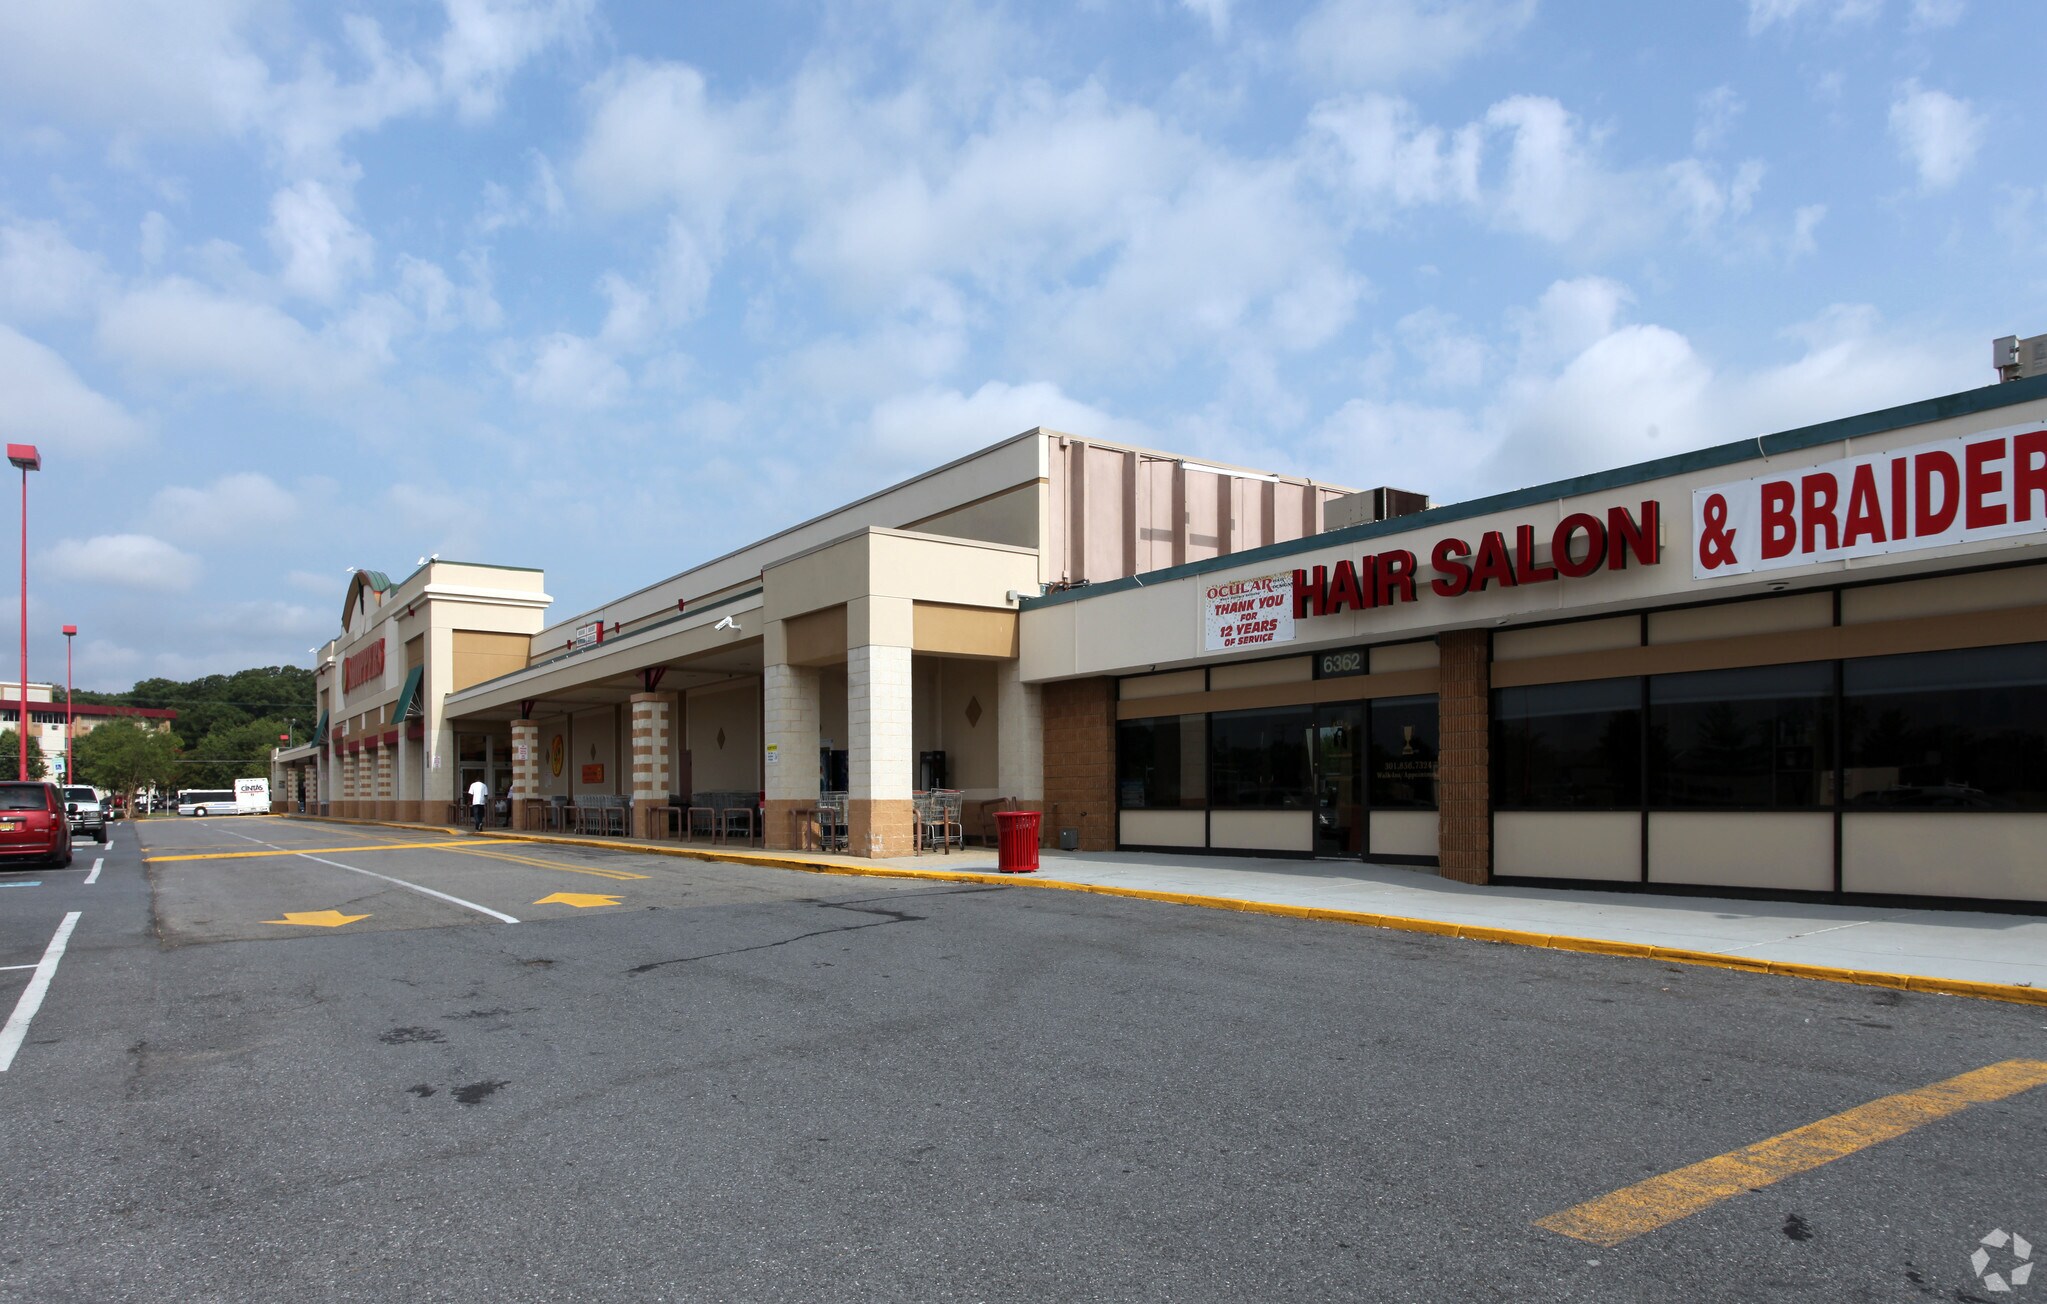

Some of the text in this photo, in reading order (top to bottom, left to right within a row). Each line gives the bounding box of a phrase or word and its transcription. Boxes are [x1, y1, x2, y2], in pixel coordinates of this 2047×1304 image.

[1698, 430, 2047, 570] & BRAIDER
[1292, 500, 1661, 619] HAIR SALON
[1207, 578, 1274, 599] OCULAR
[1214, 598, 1256, 616] THANK
[1258, 594, 1285, 610] YOU
[1240, 612, 1258, 622] FOR
[1220, 619, 1278, 638] 12 YEARS
[1224, 633, 1274, 647] OF SERVICE
[1323, 653, 1361, 673] 6362
[240, 784, 264, 792] CINTAS
